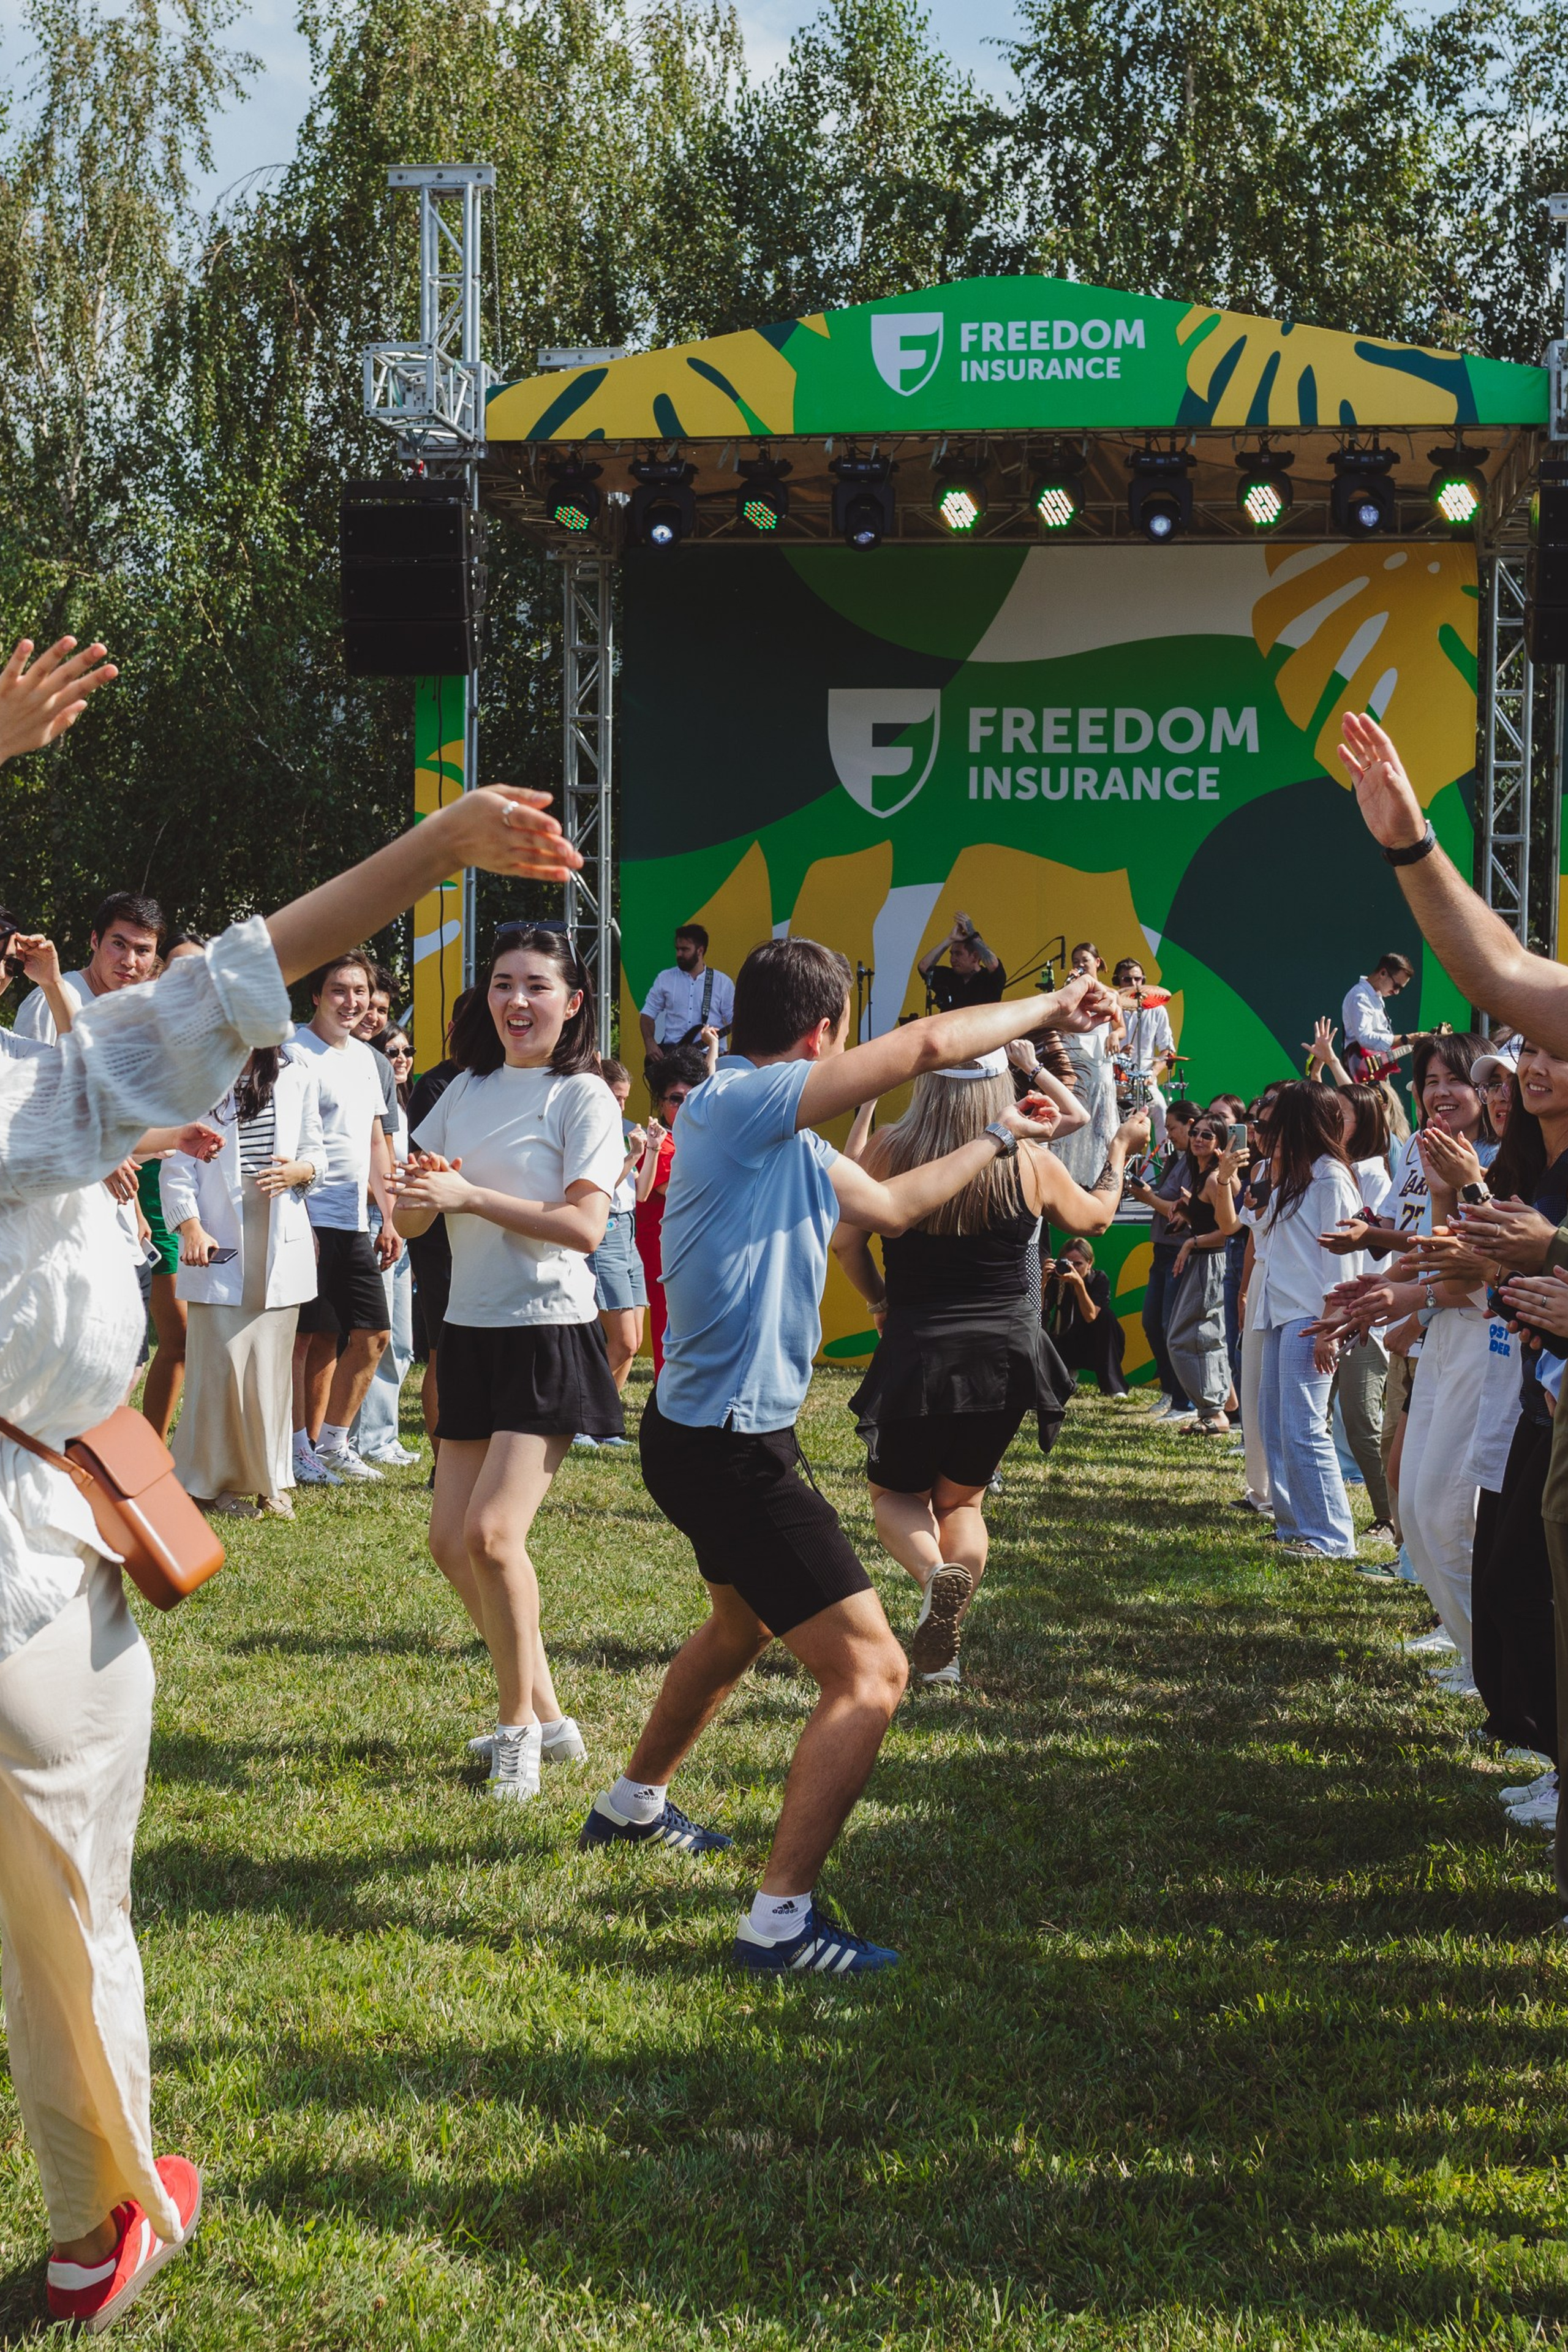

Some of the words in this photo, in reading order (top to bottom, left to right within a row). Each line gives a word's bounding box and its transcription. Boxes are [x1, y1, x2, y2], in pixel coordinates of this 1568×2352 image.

[961, 319, 1145, 352] FREEDOM
[961, 357, 1121, 382] INSURANCE
[969, 707, 1259, 754] FREEDOM
[969, 766, 1219, 801] INSURANCE
[1399, 1169, 1428, 1197] LAK
[1489, 1339, 1510, 1357] DER
[772, 1906, 799, 1915] adidas
